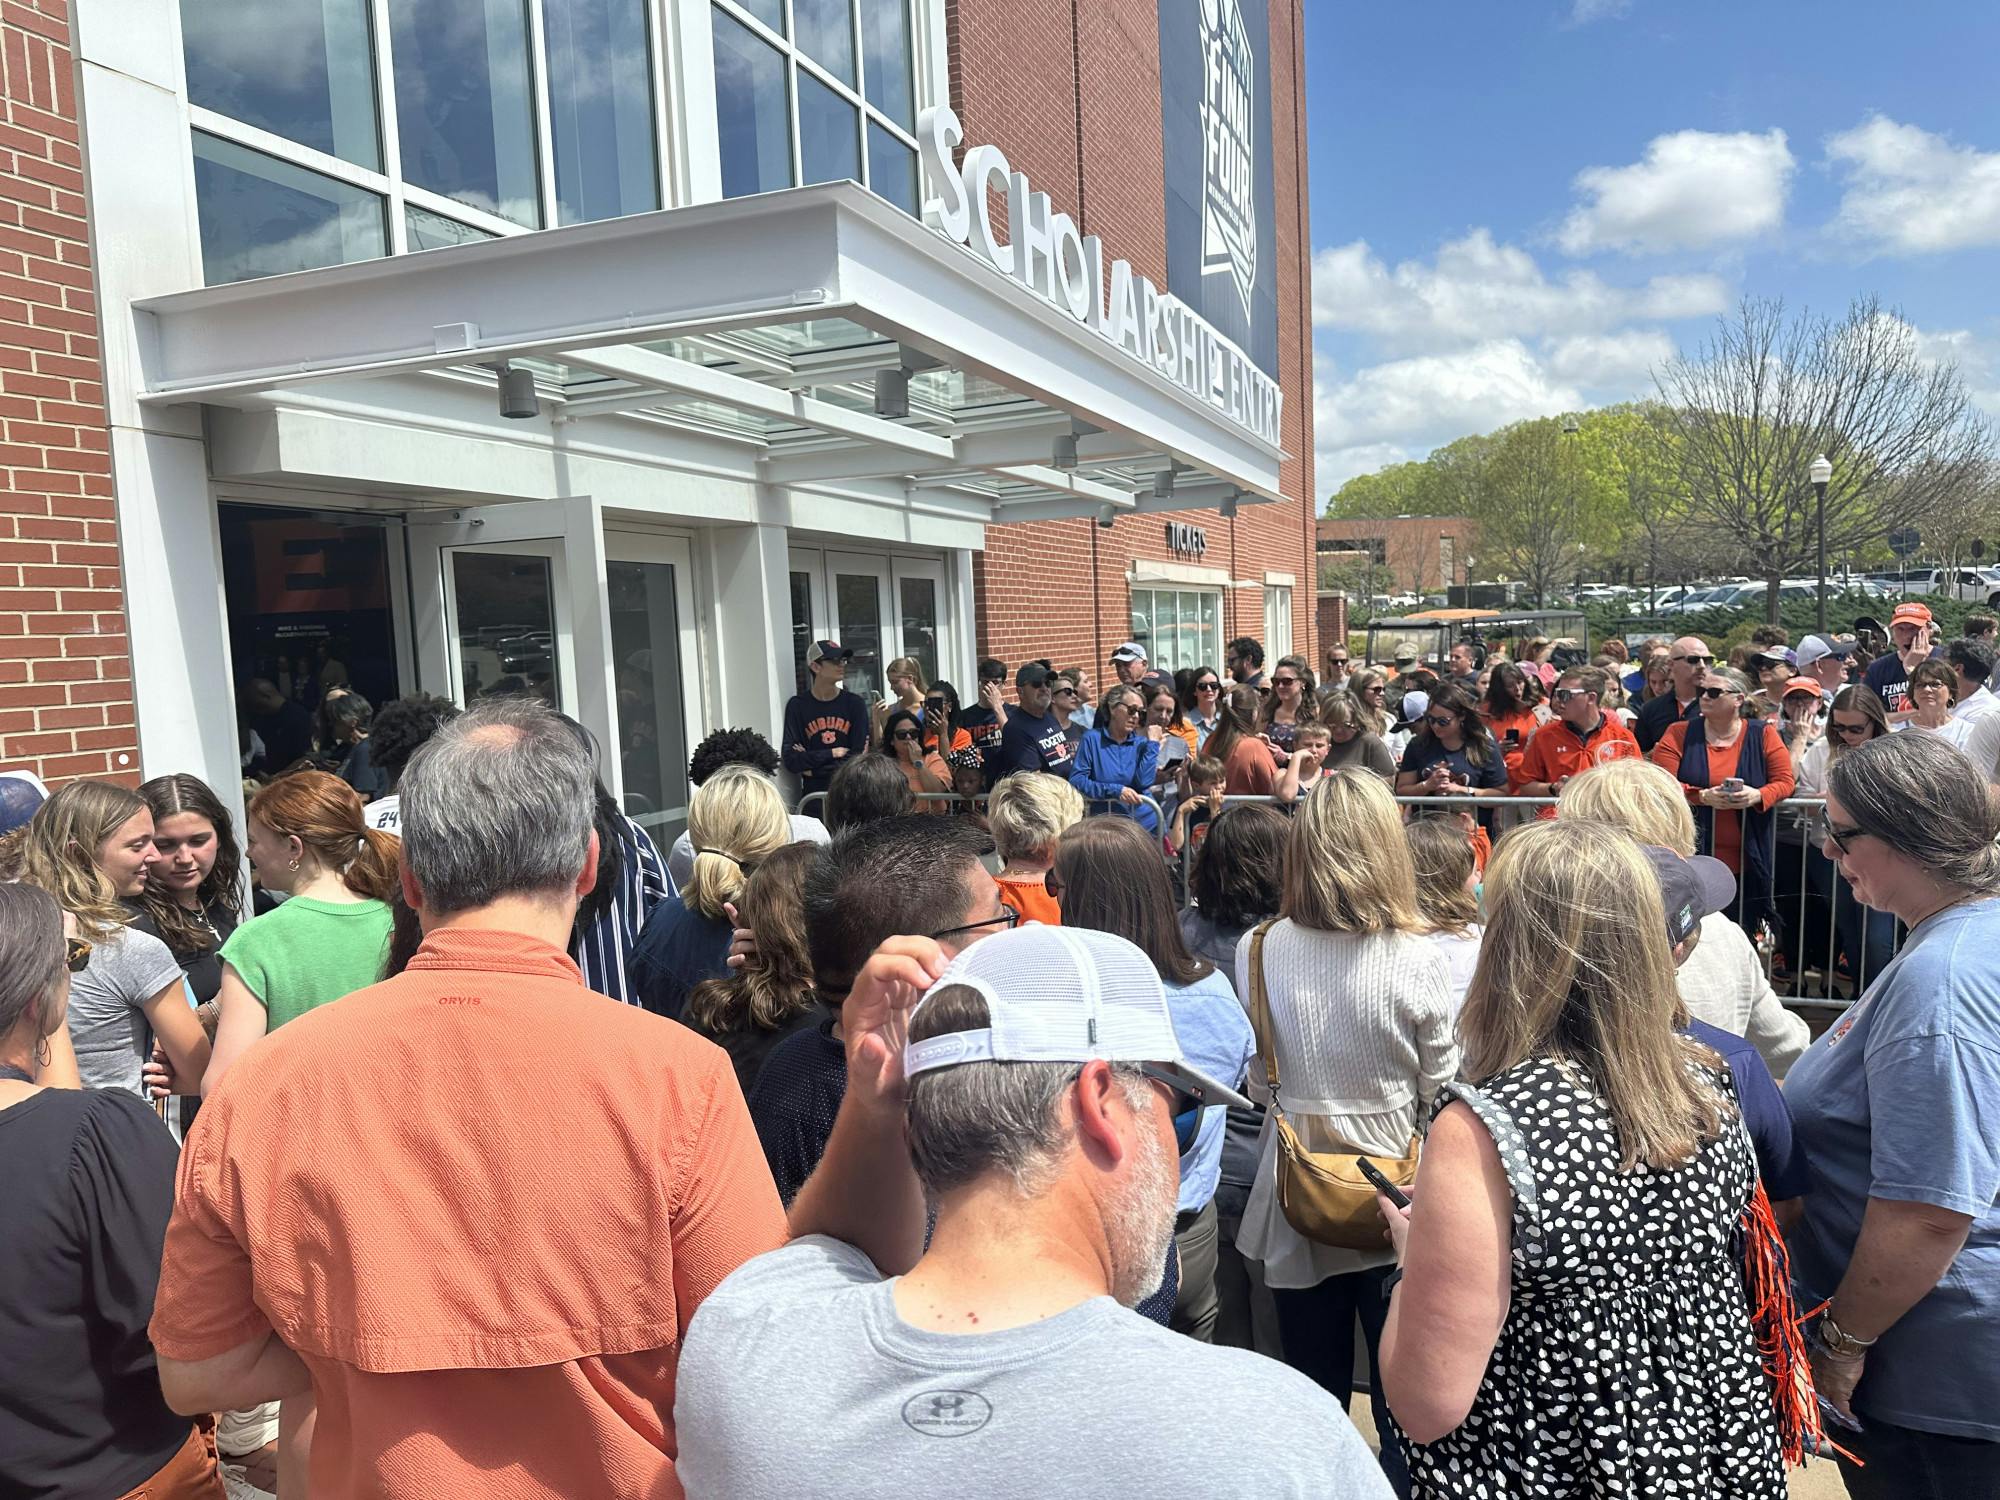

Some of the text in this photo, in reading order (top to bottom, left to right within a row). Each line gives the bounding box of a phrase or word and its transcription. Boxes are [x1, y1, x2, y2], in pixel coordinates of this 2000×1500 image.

[1206, 37, 1250, 158] FINAL
[1206, 103, 1251, 230] FOUR
[917, 104, 1284, 450] SCHOLARSHIP ENTRY
[1167, 521, 1206, 556] TICKETS
[805, 716, 852, 738] AUBURN
[377, 811, 399, 829] 24
[438, 996, 481, 1005] ORVIS
